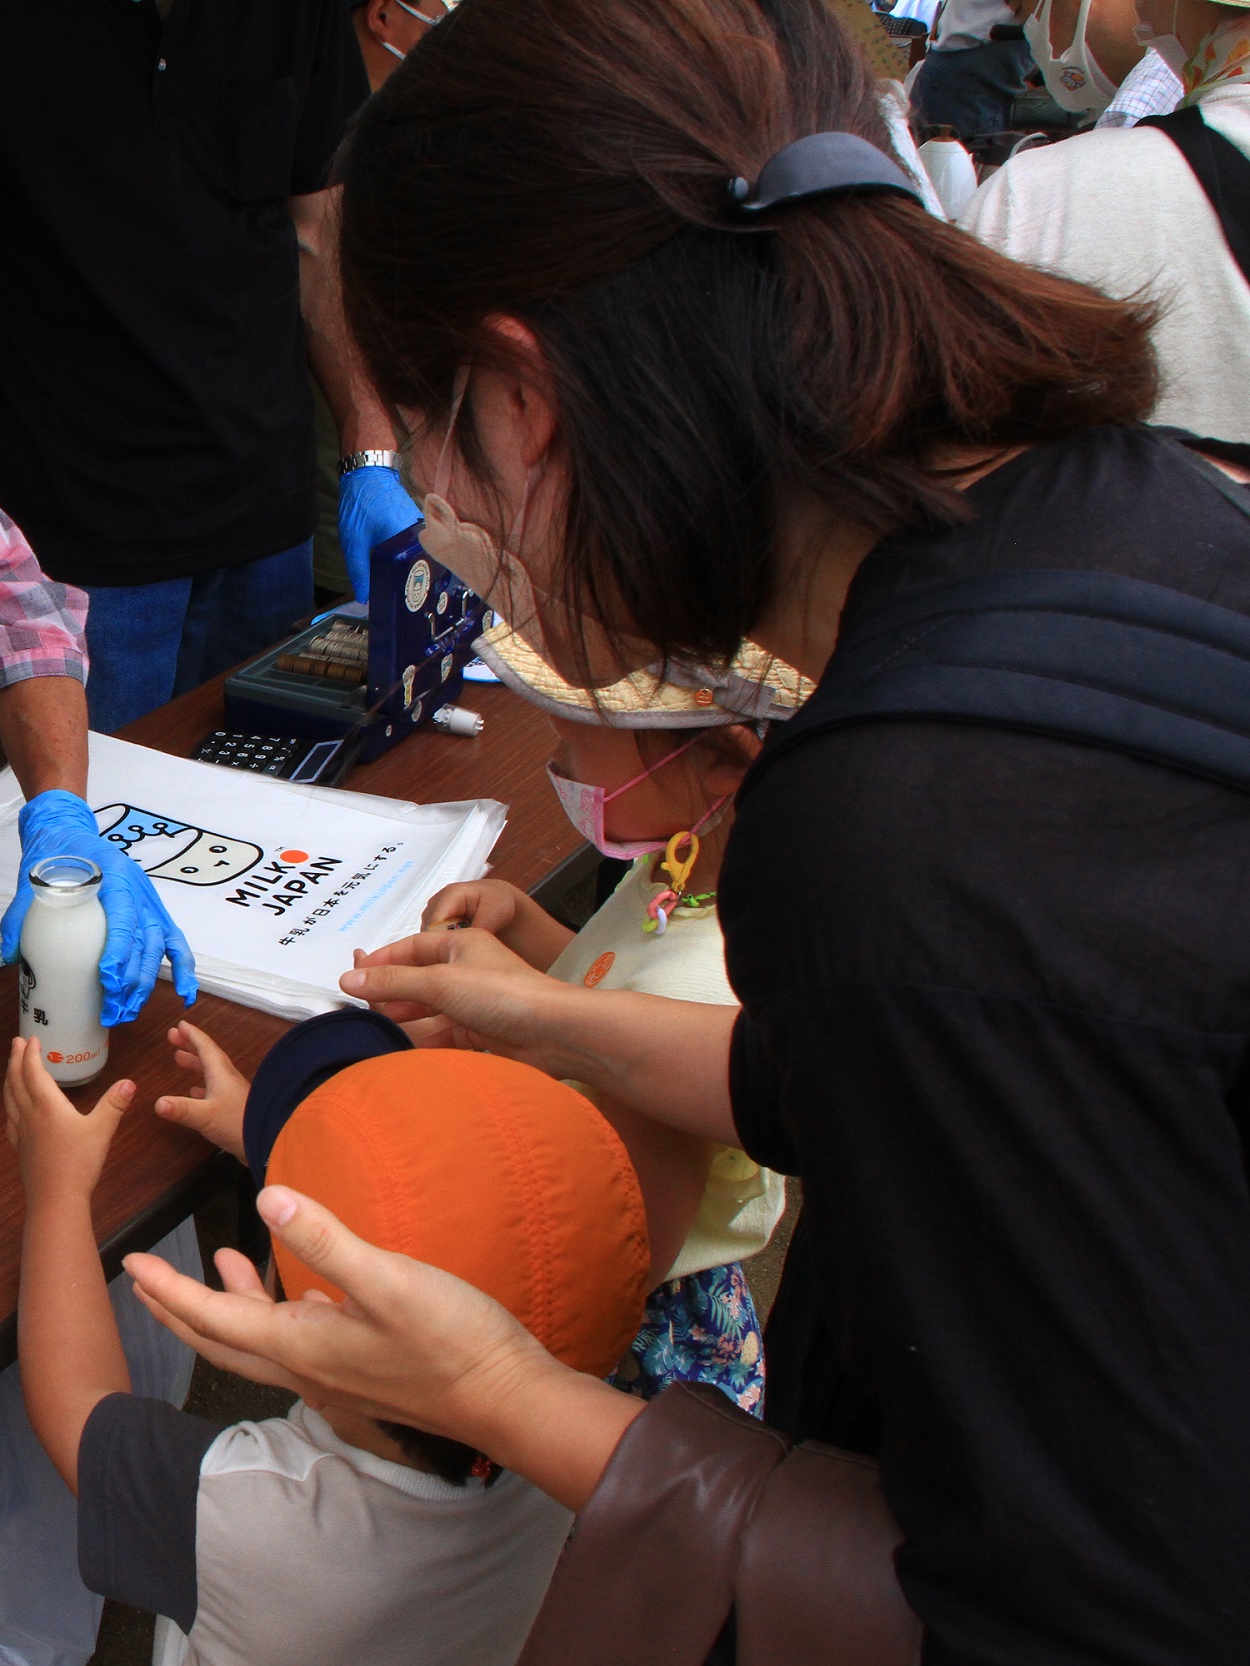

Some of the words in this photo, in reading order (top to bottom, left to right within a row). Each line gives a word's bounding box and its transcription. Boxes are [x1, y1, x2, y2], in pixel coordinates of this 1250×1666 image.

[225, 861, 296, 907] MILK
[262, 856, 343, 916] JAPAN
[278, 842, 404, 946] 牛乳が日本を元気にする。
